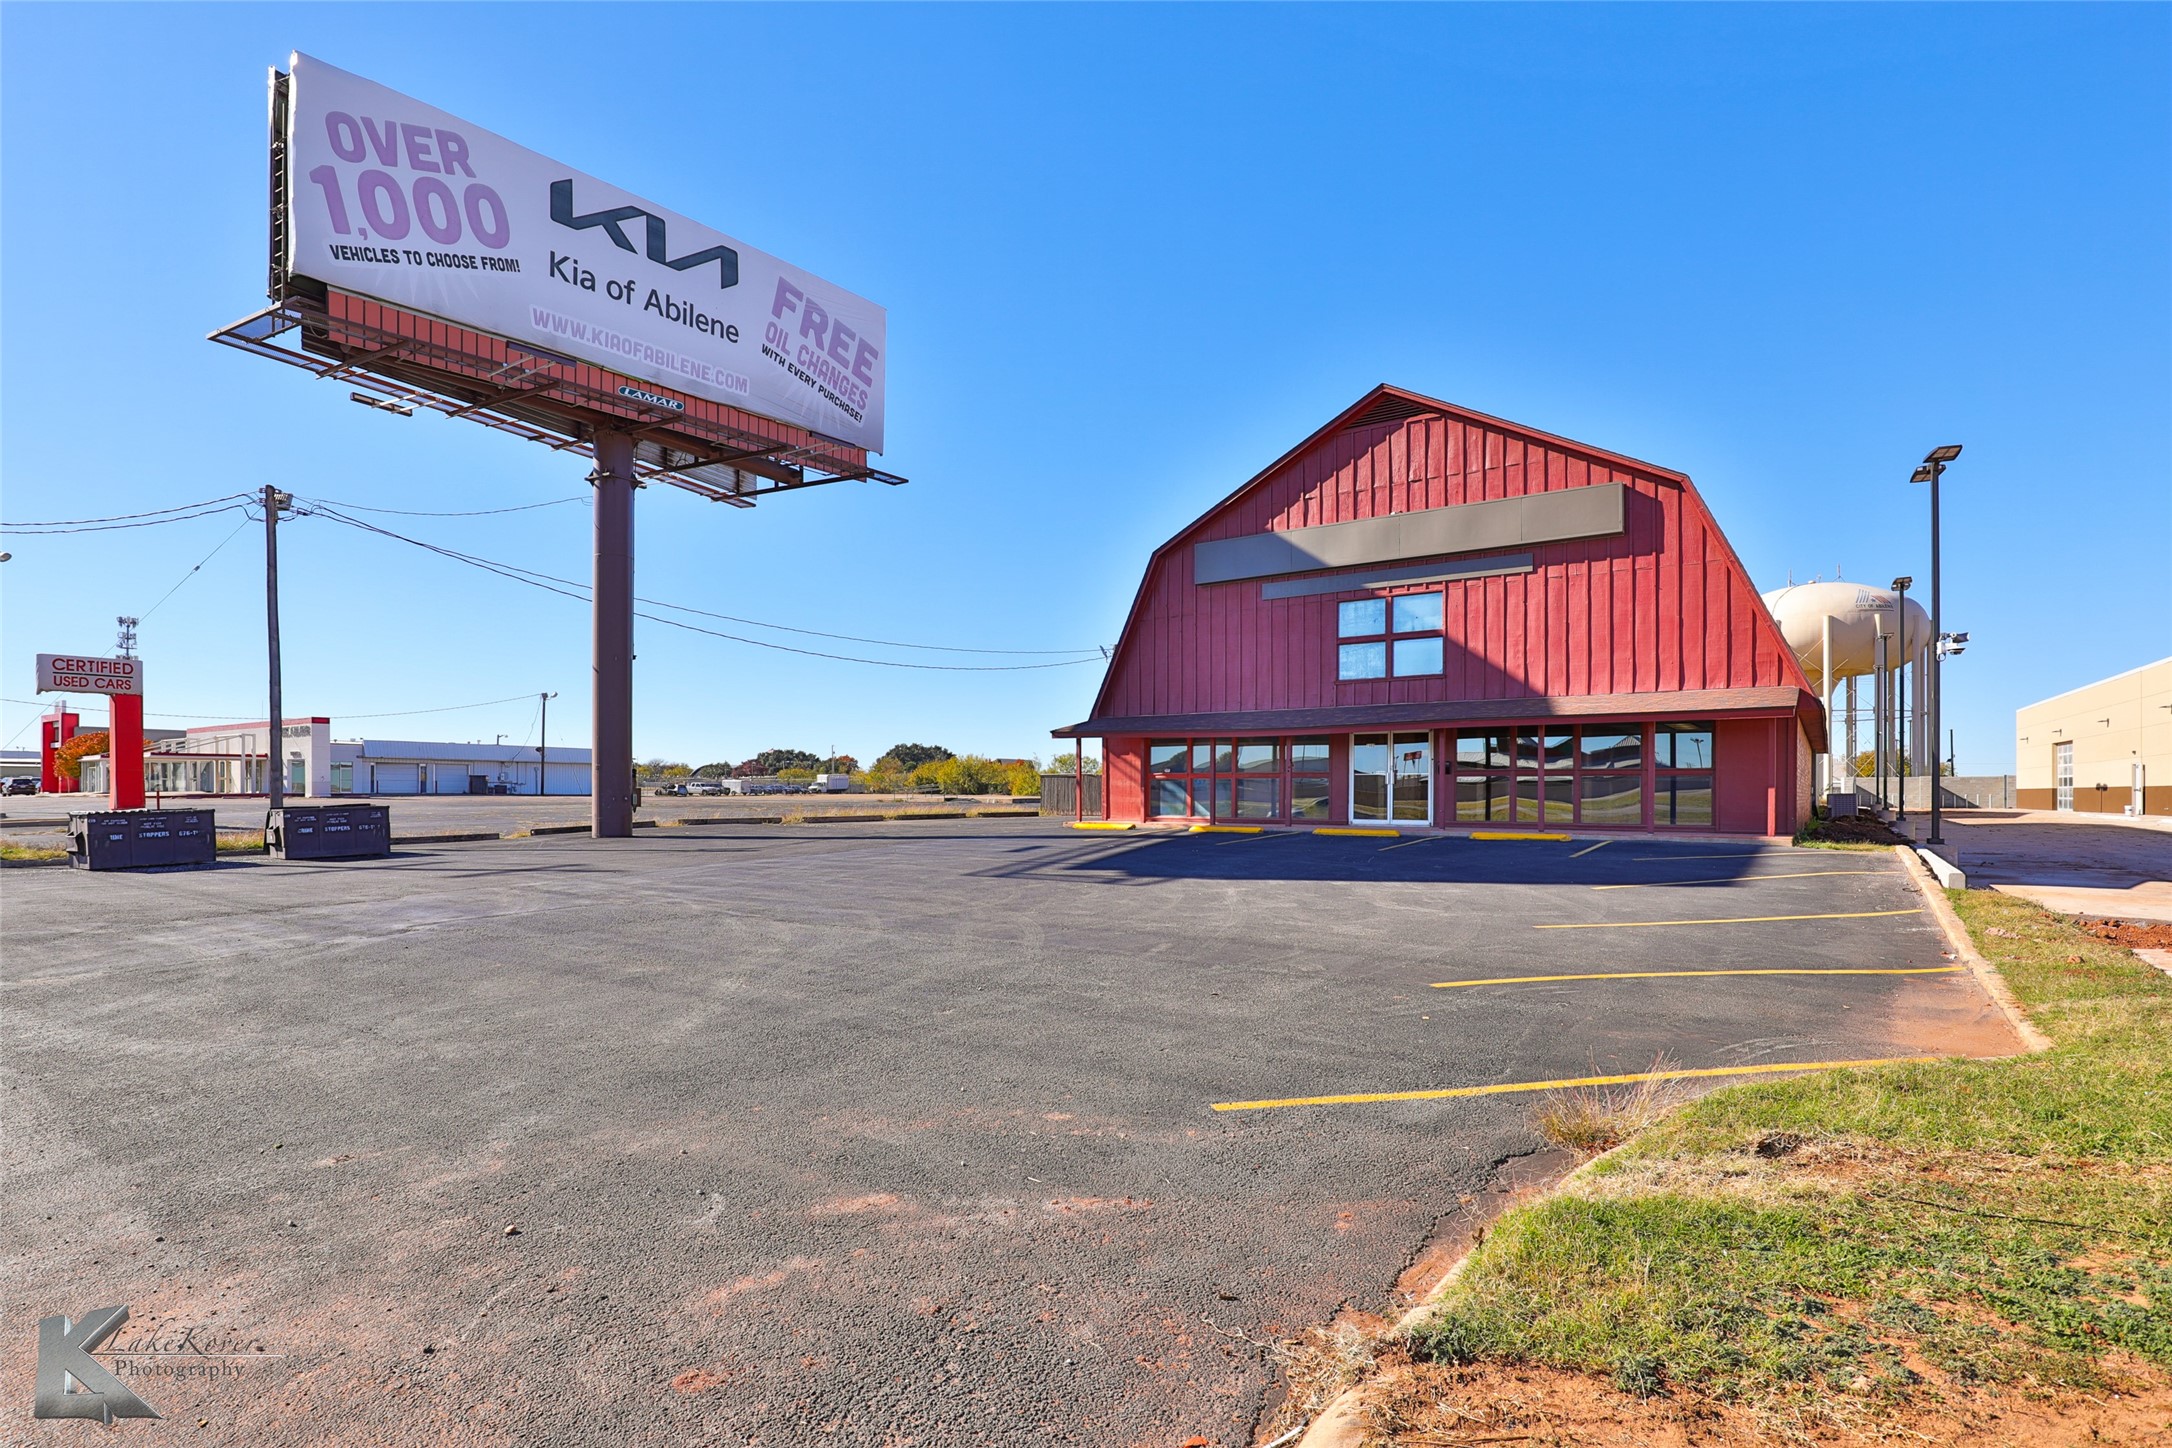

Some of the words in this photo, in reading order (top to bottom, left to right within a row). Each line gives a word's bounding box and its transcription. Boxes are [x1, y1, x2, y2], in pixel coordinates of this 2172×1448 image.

[325, 110, 477, 178] OVER
[308, 164, 511, 249] 1,000
[329, 244, 400, 264] VEHICLES
[402, 249, 423, 266] TO
[426, 251, 478, 270] CHOOSE
[481, 256, 521, 273] FROM!
[549, 250, 596, 293] Kia
[606, 279, 636, 305] of
[643, 289, 740, 343] Abilene
[532, 307, 748, 394] WWW.KIAOFABILENE.COM
[764, 321, 791, 357] OIL
[796, 343, 869, 411] CHANGES
[771, 275, 879, 388] FREE
[624, 388, 678, 409] LAMAR
[761, 343, 786, 368] WITH
[787, 362, 817, 389] EVERY
[817, 384, 863, 424] PURCHASE!
[52, 657, 134, 675] CERTIFIED
[53, 675, 89, 688] USED
[94, 677, 132, 690] CARS
